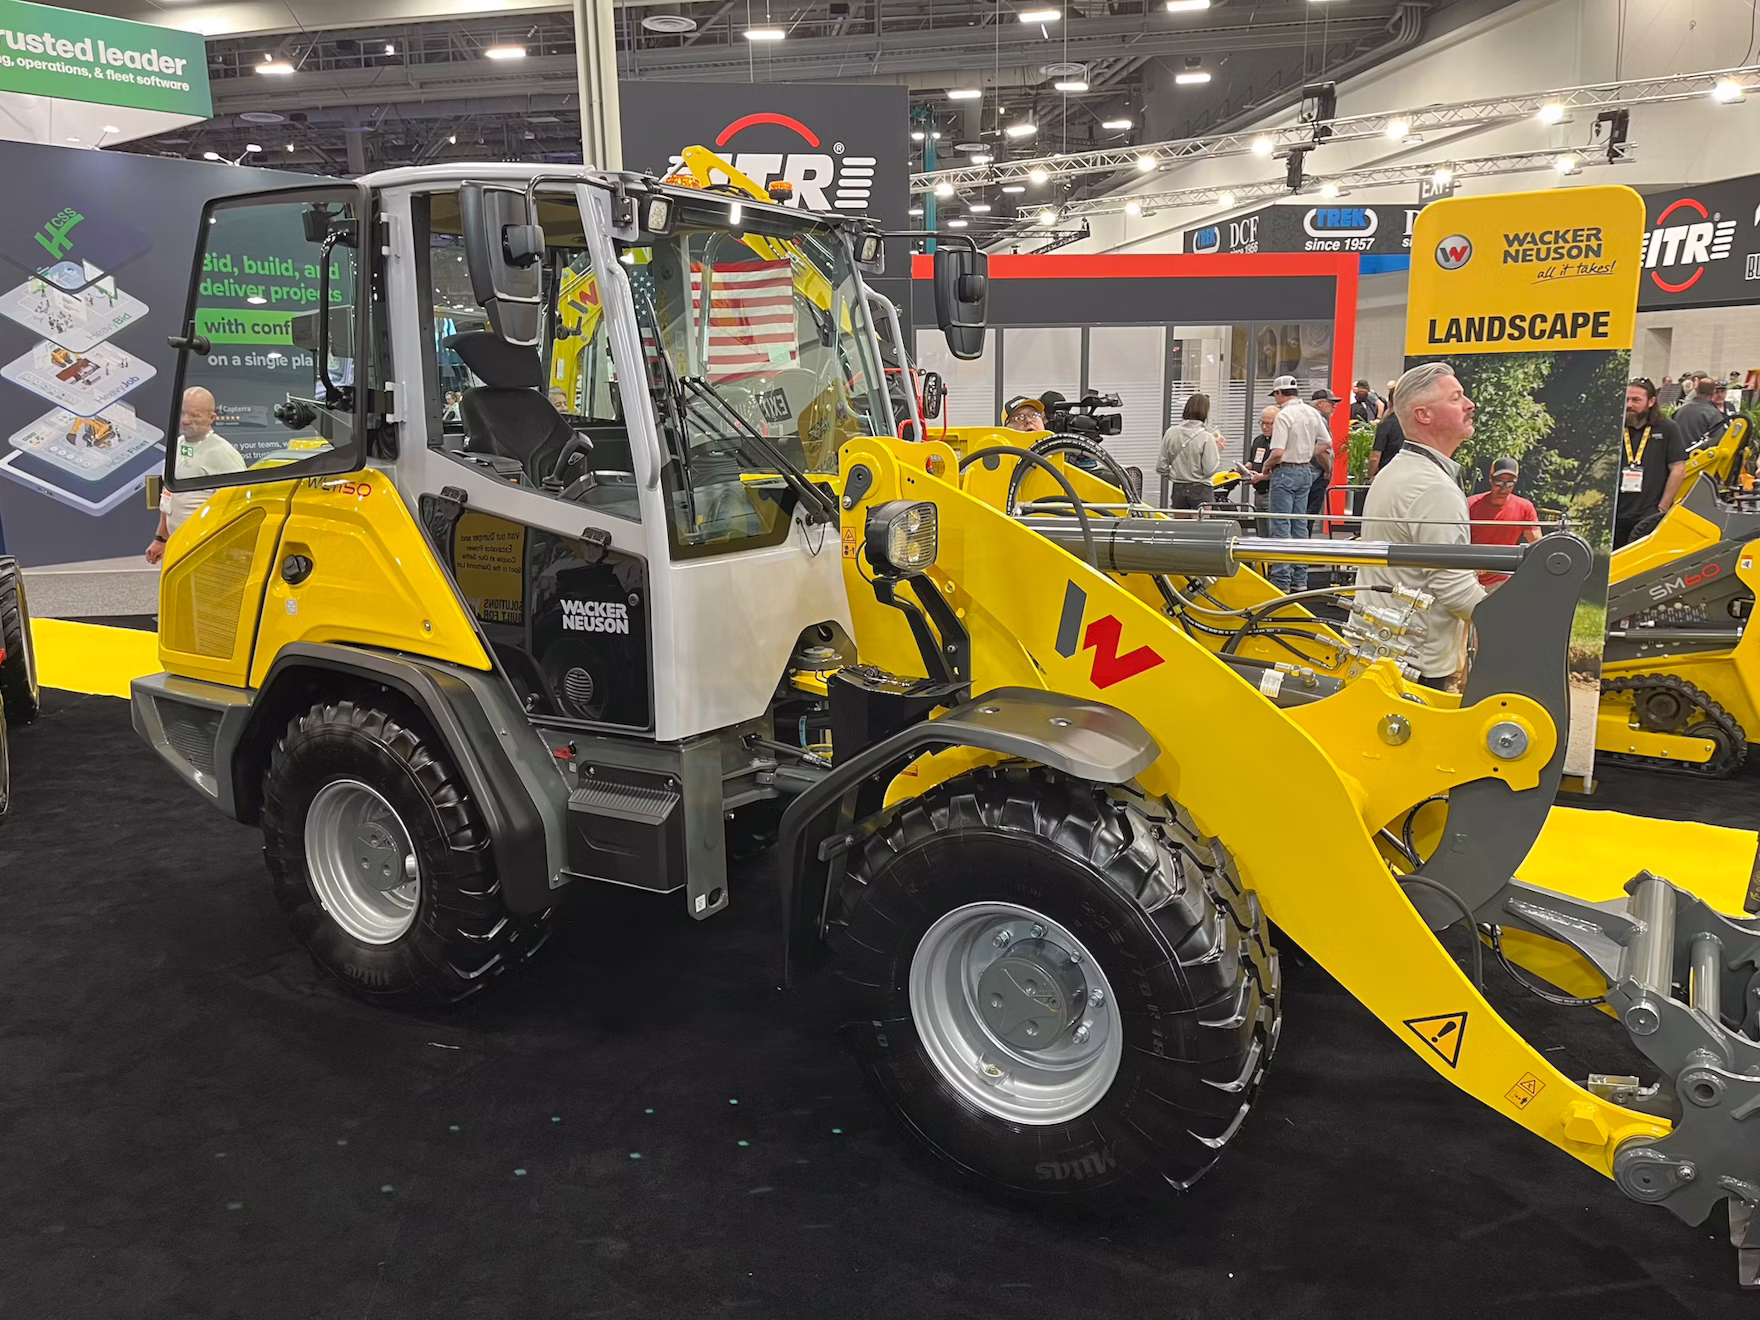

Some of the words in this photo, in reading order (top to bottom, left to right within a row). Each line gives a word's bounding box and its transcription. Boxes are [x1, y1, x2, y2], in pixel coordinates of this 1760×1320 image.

[97, 39, 187, 76] leader
[16, 56, 93, 79] operations,
[93, 66, 104, 79] &
[106, 69, 135, 84] fleet
[136, 75, 190, 92] software
[1315, 208, 1367, 228] TREK
[1229, 215, 1259, 249] DCF
[1503, 227, 1603, 248] WACKER
[1305, 239, 1340, 251] since
[1344, 237, 1376, 251] 1957
[1503, 243, 1602, 265] NEUSON
[1645, 222, 1714, 269] ITR
[202, 252, 239, 276] Bid,
[243, 255, 300, 280] build,
[1537, 266, 1556, 279] all
[1560, 263, 1575, 276] it
[1577, 260, 1617, 275] takes!
[199, 278, 266, 298] deliver
[204, 317, 246, 334] with
[1428, 311, 1611, 344] LANDSCAPE
[208, 354, 228, 366] on
[232, 354, 241, 366] a
[245, 352, 288, 369] single
[240, 442, 257, 450] your
[258, 441, 282, 449] teams,
[1648, 563, 1722, 601] SM60
[560, 599, 629, 619] WACKER
[562, 614, 629, 635] NEUSON
